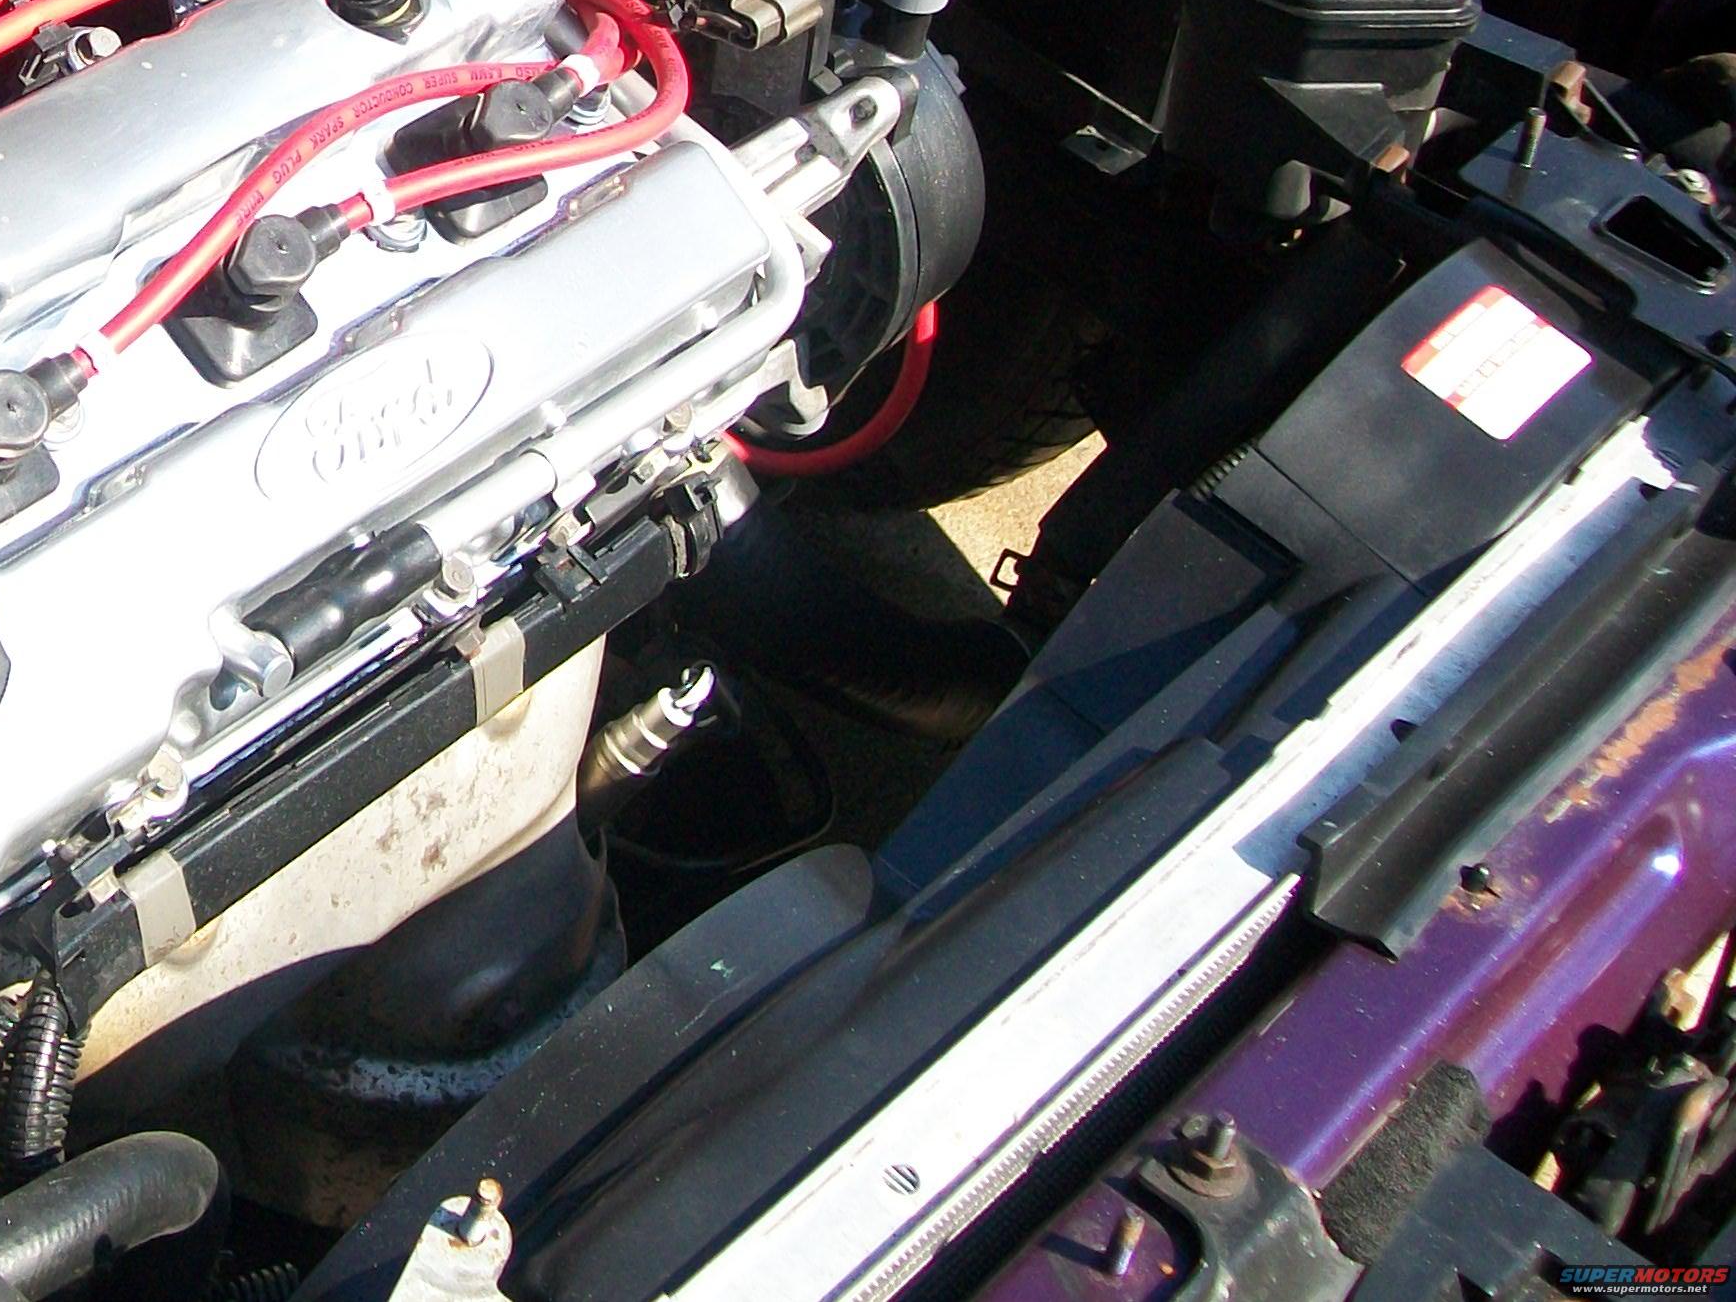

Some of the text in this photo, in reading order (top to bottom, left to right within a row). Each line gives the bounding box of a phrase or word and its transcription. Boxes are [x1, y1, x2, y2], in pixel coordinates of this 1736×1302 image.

[425, 72, 459, 90] SUPER
[352, 82, 414, 119] CONDUCTOR
[308, 116, 345, 151] SPARK
[272, 148, 303, 185] PLUG
